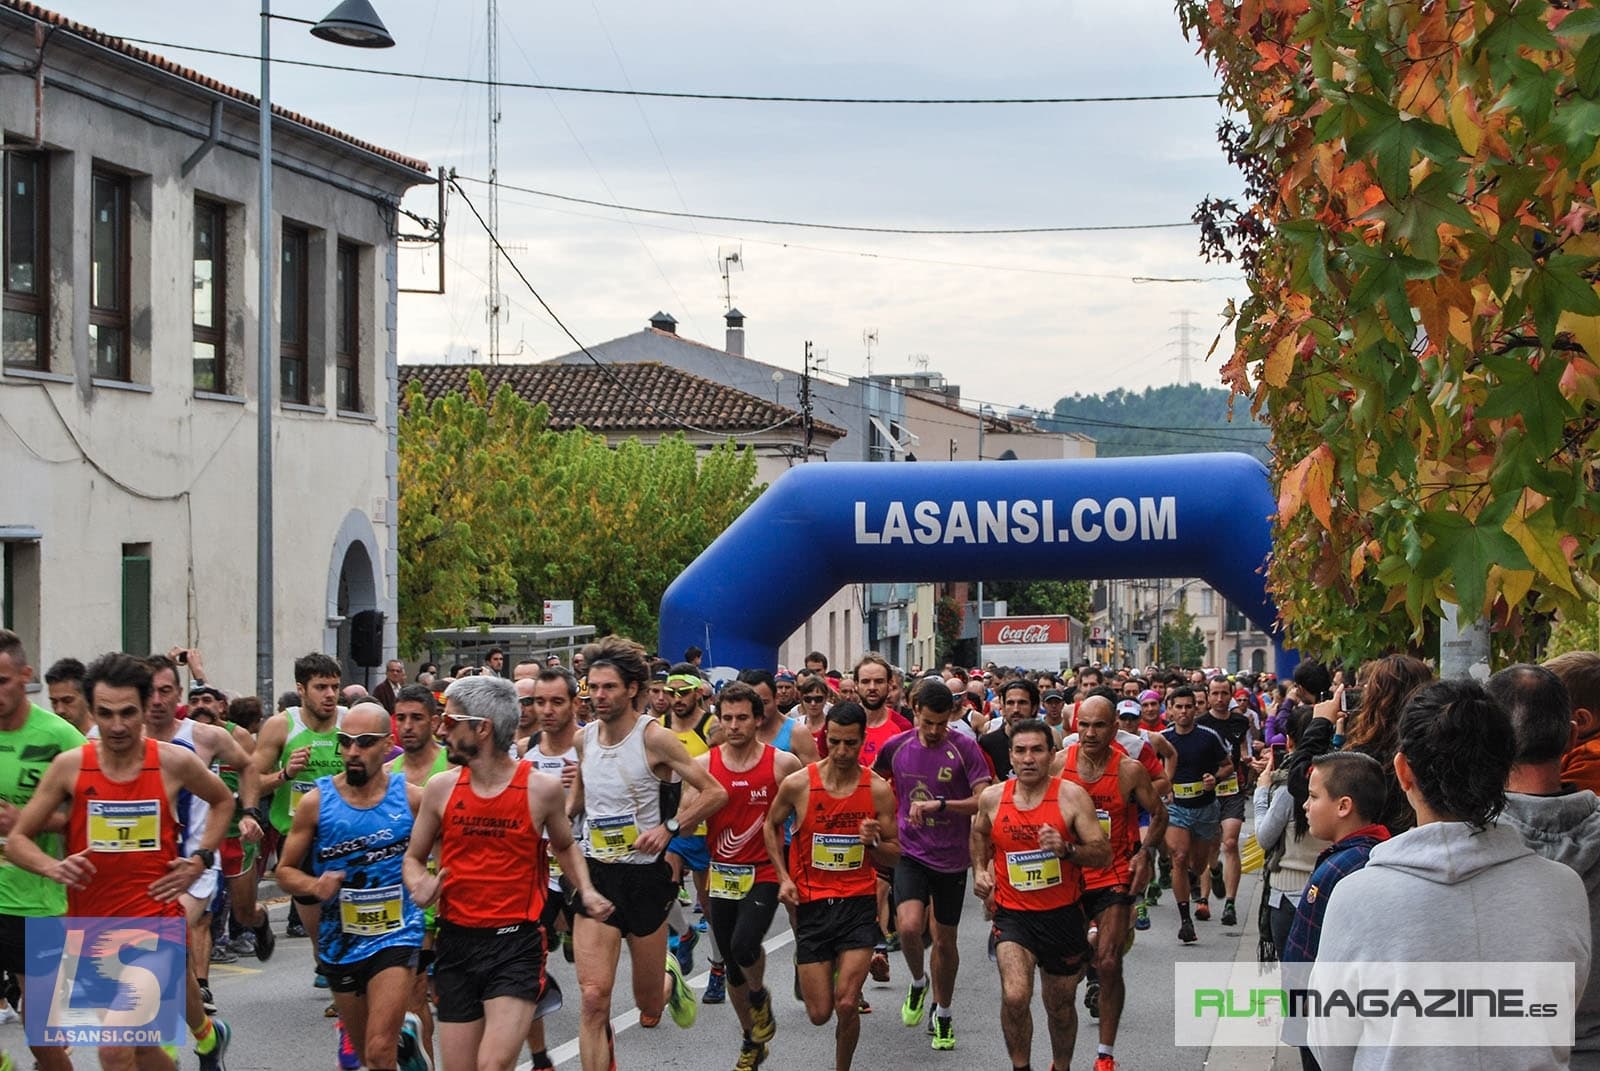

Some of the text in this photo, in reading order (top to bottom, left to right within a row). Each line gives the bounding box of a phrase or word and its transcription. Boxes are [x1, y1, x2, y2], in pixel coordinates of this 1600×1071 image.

[854, 496, 1177, 544] LASANSI.COM
[937, 767, 952, 782] LS
[117, 826, 130, 840] 17
[833, 853, 844, 863] 19
[1026, 869, 1042, 881] 772
